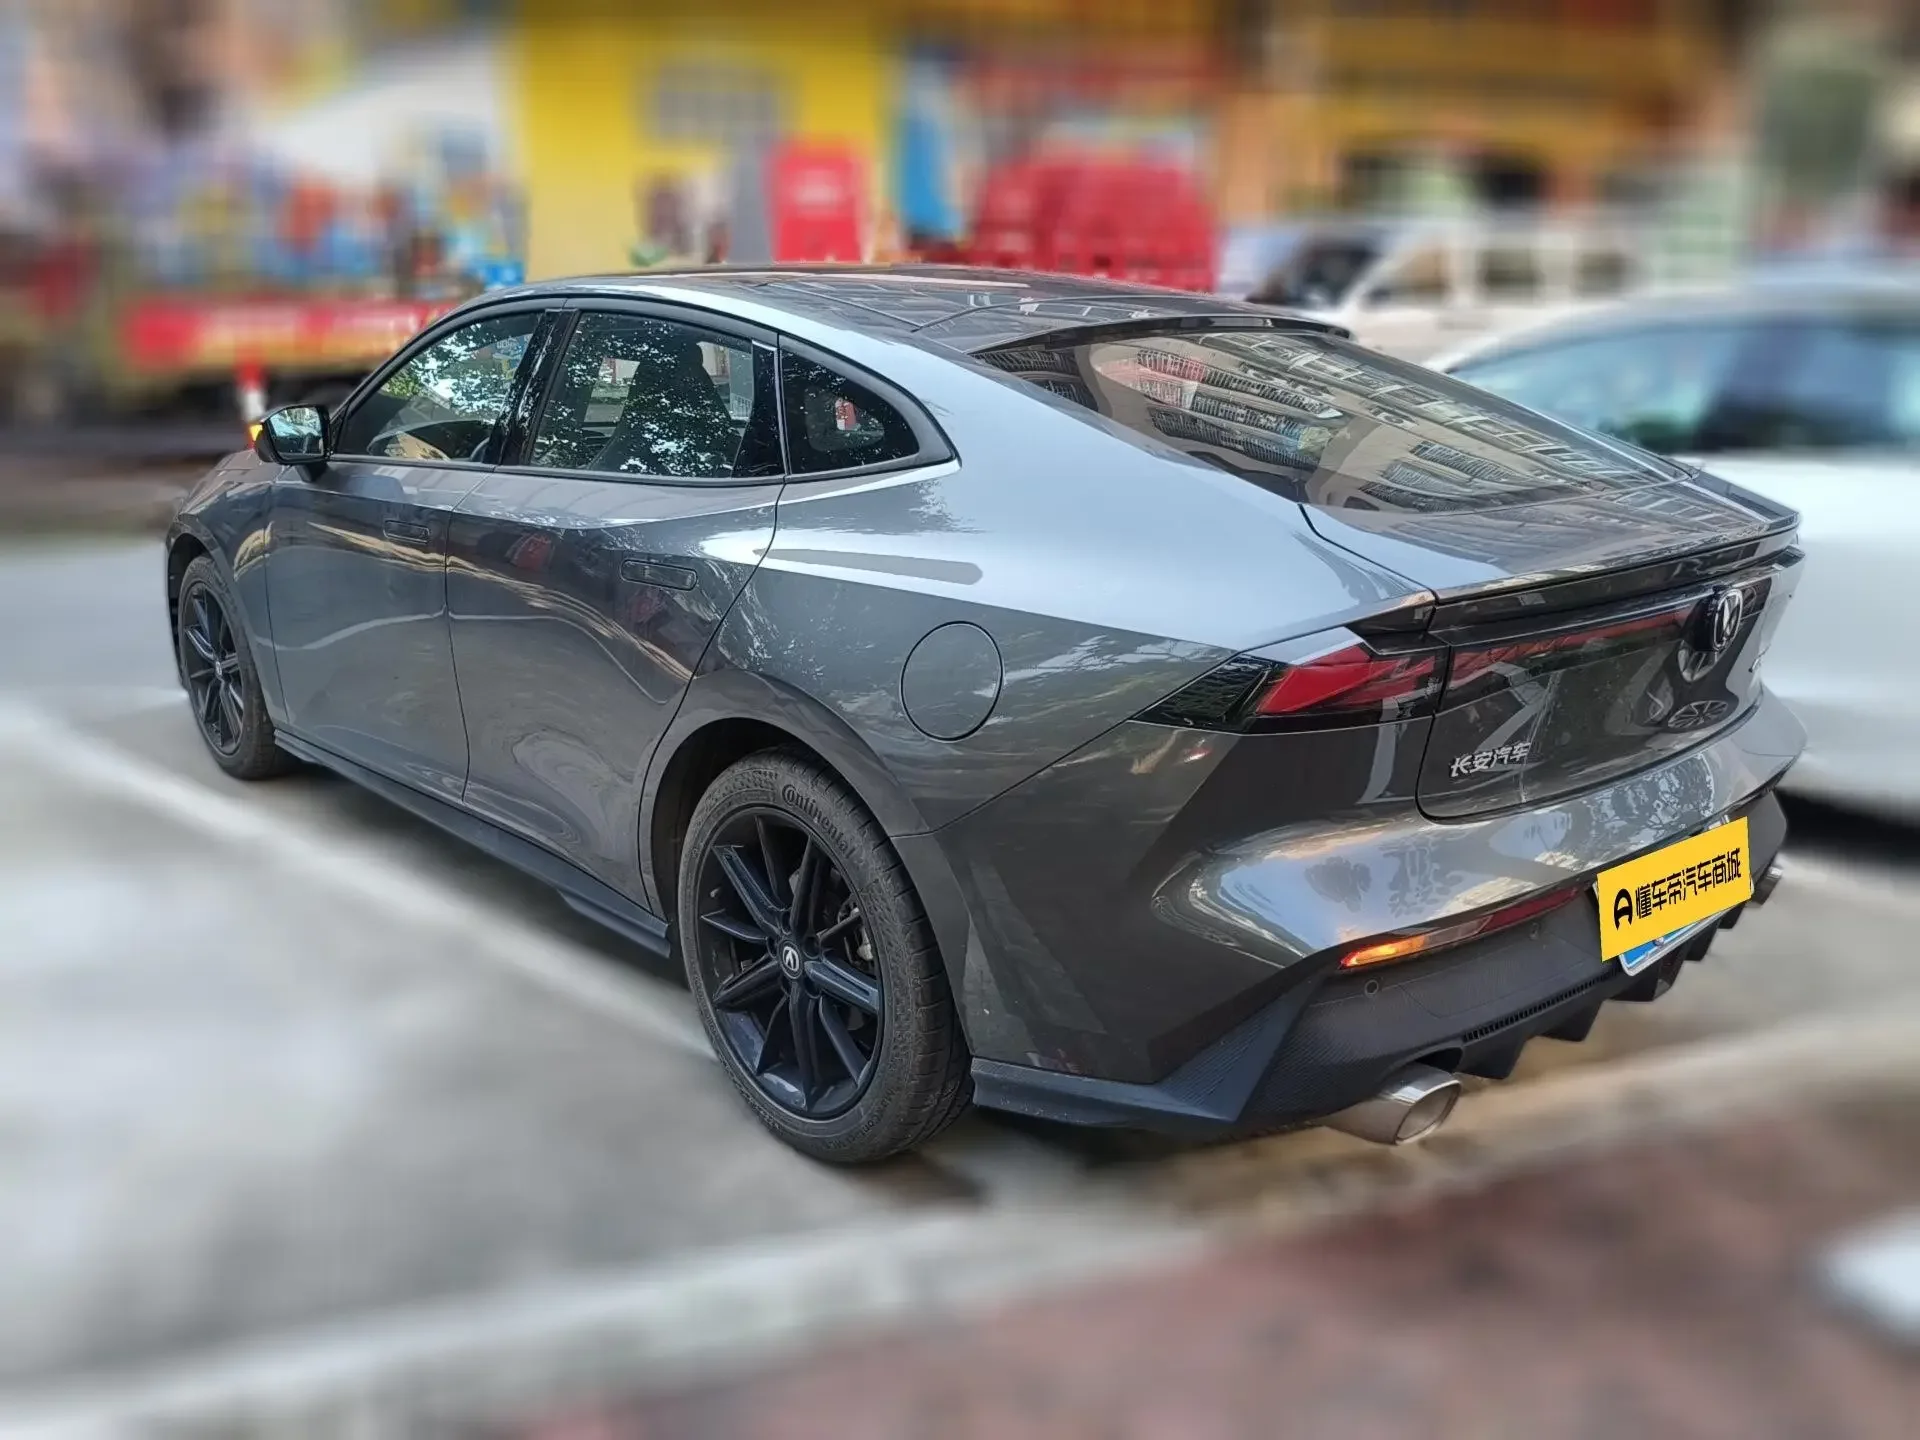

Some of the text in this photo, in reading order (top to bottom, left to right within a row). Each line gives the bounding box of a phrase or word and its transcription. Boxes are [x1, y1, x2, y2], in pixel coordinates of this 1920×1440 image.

[1450, 742, 1531, 777] 长安汽车
[782, 784, 856, 859] Continental
